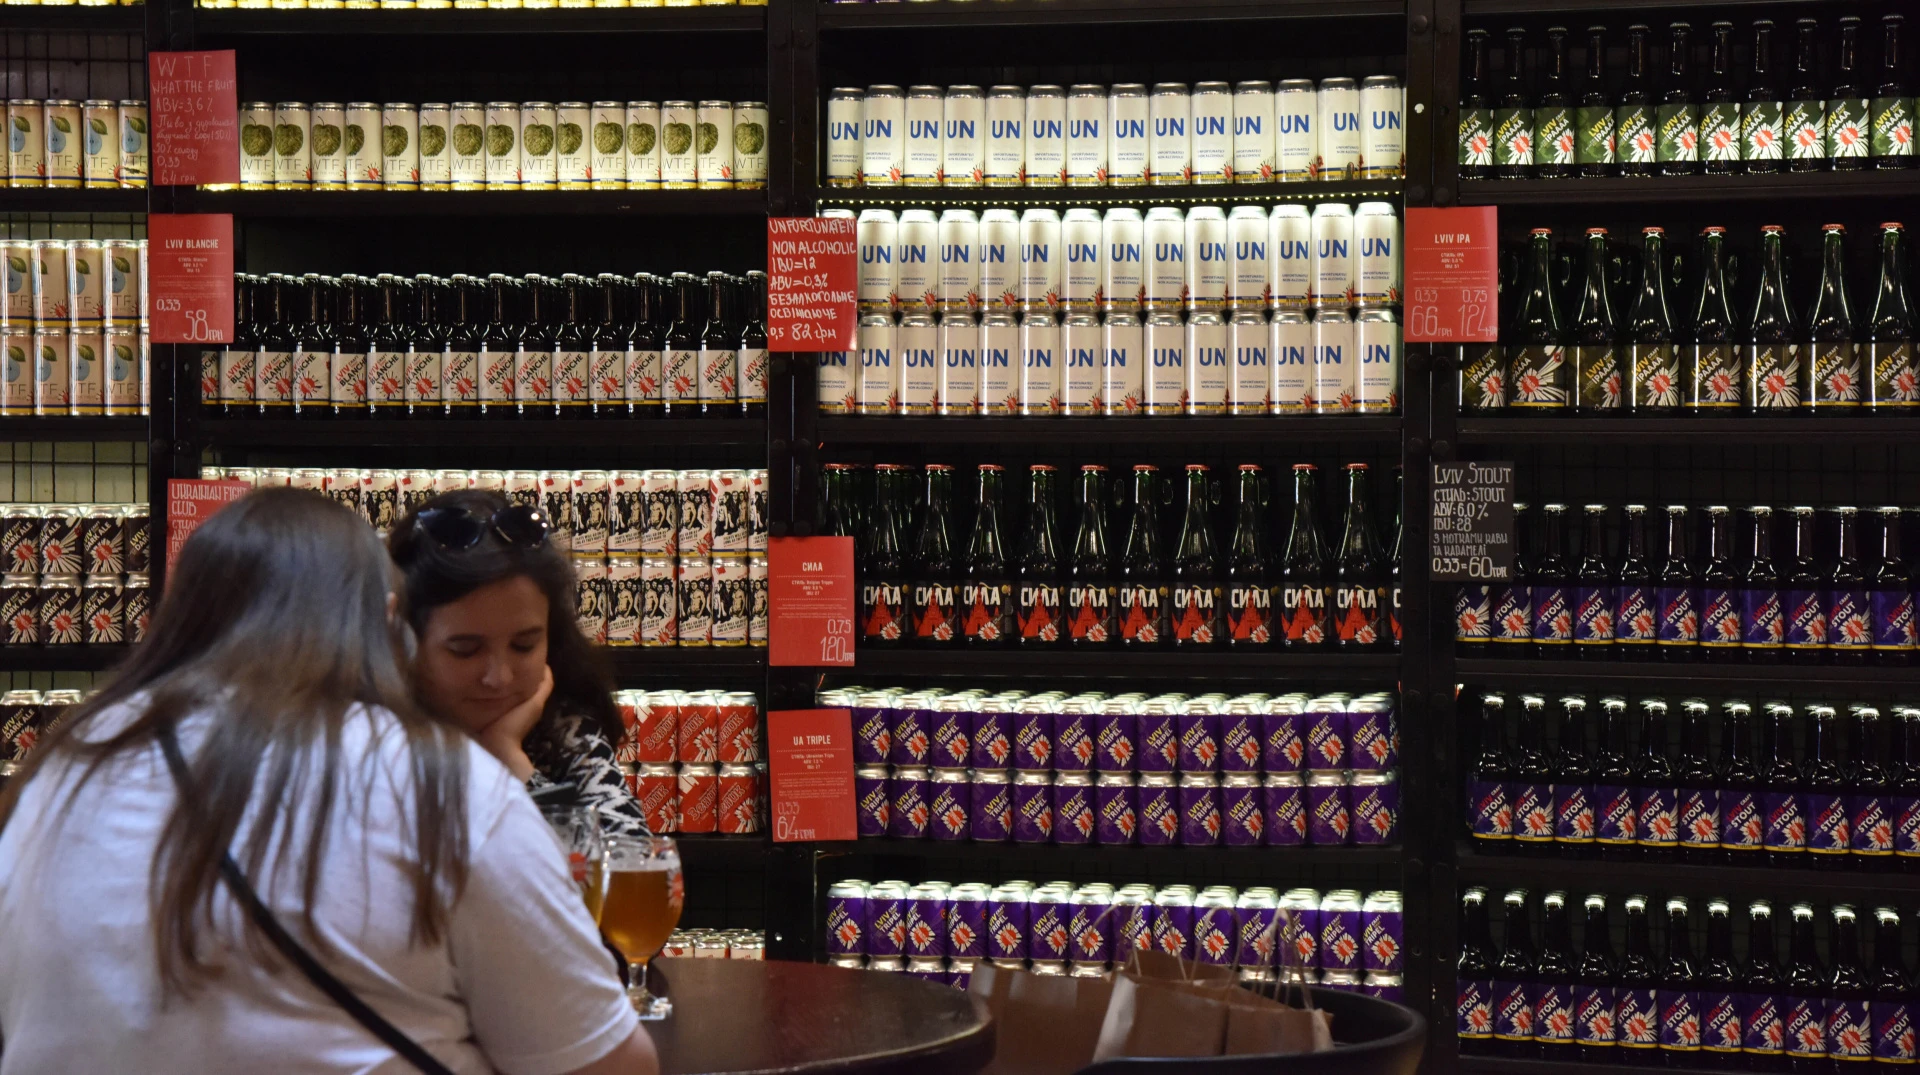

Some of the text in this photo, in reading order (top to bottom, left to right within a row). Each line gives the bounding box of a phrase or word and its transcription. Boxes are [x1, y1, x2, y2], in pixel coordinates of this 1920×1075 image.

[151, 80, 236, 94] WHAT THE FRUIT
[1033, 120, 1062, 139] UN
[1116, 120, 1144, 138] UN
[1196, 117, 1225, 135] UN
[1281, 115, 1310, 134] UN
[1373, 111, 1400, 130] UN
[831, 122, 859, 141] UN
[910, 121, 939, 139] UN
[156, 155, 180, 168] 0,33
[241, 159, 272, 171] WTF
[453, 158, 482, 170] WTF
[524, 159, 553, 171] WTF
[662, 158, 691, 170] WTF
[734, 157, 764, 169] WTF
[769, 218, 855, 234] UNFORTUNATELY
[165, 239, 219, 249] LVIV BLANCHE
[1362, 238, 1391, 257] UN
[1434, 233, 1470, 244] LVIV IPA
[862, 245, 891, 264] UN
[941, 245, 969, 263] UN
[1111, 244, 1140, 262] UN
[1318, 240, 1347, 258] UN
[156, 299, 181, 311] 0,33
[769, 291, 855, 305] БЕЗАЛКОГОЛЬНЕ
[1415, 289, 1488, 303] 0,33 0,75
[770, 327, 784, 340] 0,5
[792, 323, 812, 340] 82
[862, 349, 890, 367] UN
[906, 350, 934, 368] UN
[1065, 349, 1094, 367] UN
[1153, 349, 1182, 367] UN
[262, 355, 292, 385] BLANCHE
[445, 355, 474, 385] BLANCHE
[628, 352, 656, 384] BLANCHE
[707, 352, 735, 383] BLANCHE
[172, 483, 221, 500] UKRAINIAN
[172, 501, 197, 516] CLUB
[802, 562, 823, 572] СИЛА
[864, 586, 901, 605] СИЛА
[915, 587, 953, 606] СИЛА
[1020, 587, 1059, 607] СИЛА
[1120, 588, 1158, 608] СИЛА
[1337, 589, 1377, 608] СИЛА
[43, 592, 71, 621] DARK ALE
[1540, 597, 1565, 624] STOUT
[1707, 600, 1732, 626] STOUT
[827, 619, 852, 634] 0,75
[5, 708, 35, 740] DARK ALE
[863, 721, 885, 741] TRIPEL
[793, 735, 831, 745] UA TRIPLE
[1063, 728, 1086, 748] TRIPEL
[1357, 726, 1380, 747] TRIPEL
[777, 801, 800, 815] 0,33
[1026, 799, 1047, 819] TRIPEL
[1320, 800, 1341, 821] TRIPEL
[1482, 791, 1507, 817] STOUT
[1608, 796, 1632, 823] STOUT
[879, 911, 901, 934] TRIPEL
[1457, 990, 1481, 1016] STOUT
[1885, 1014, 1910, 1041] STOUT
